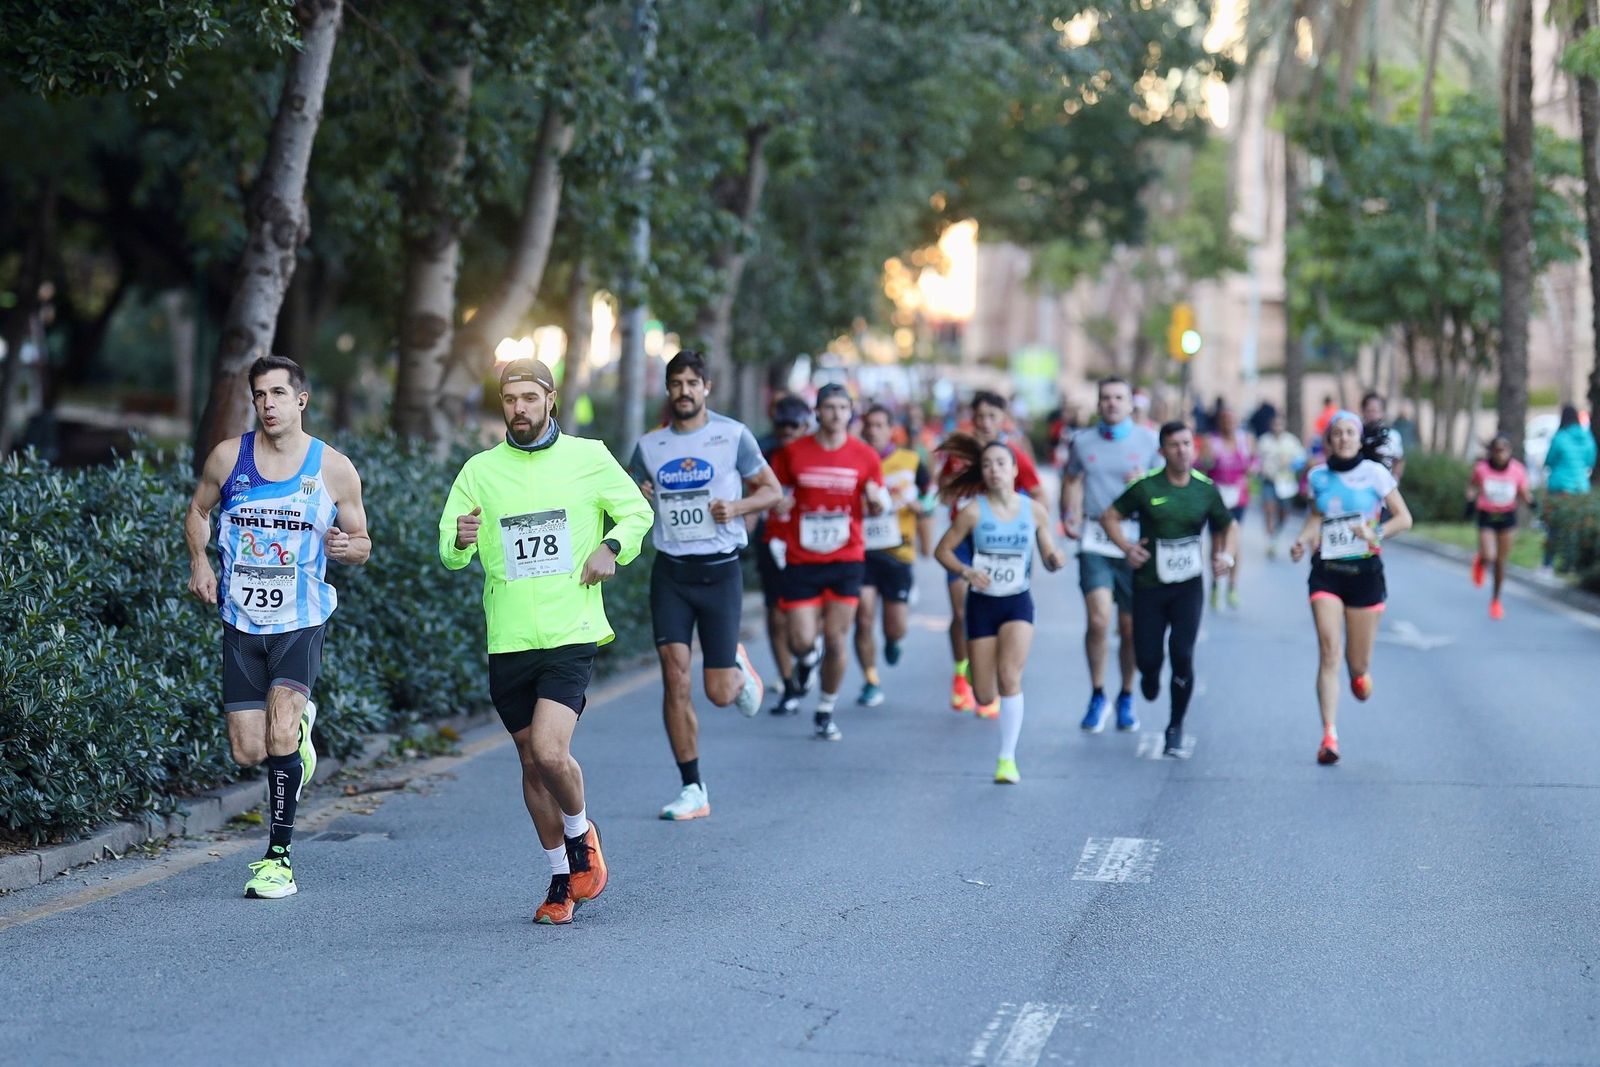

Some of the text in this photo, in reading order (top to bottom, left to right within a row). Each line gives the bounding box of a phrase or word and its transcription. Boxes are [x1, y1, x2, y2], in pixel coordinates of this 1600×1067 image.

[658, 466, 712, 482] Fontestad
[240, 507, 301, 518] ATLETISMO
[669, 508, 703, 526] 300
[230, 515, 313, 531] MÁLAGA
[515, 534, 559, 560] 178
[242, 587, 284, 608] 739
